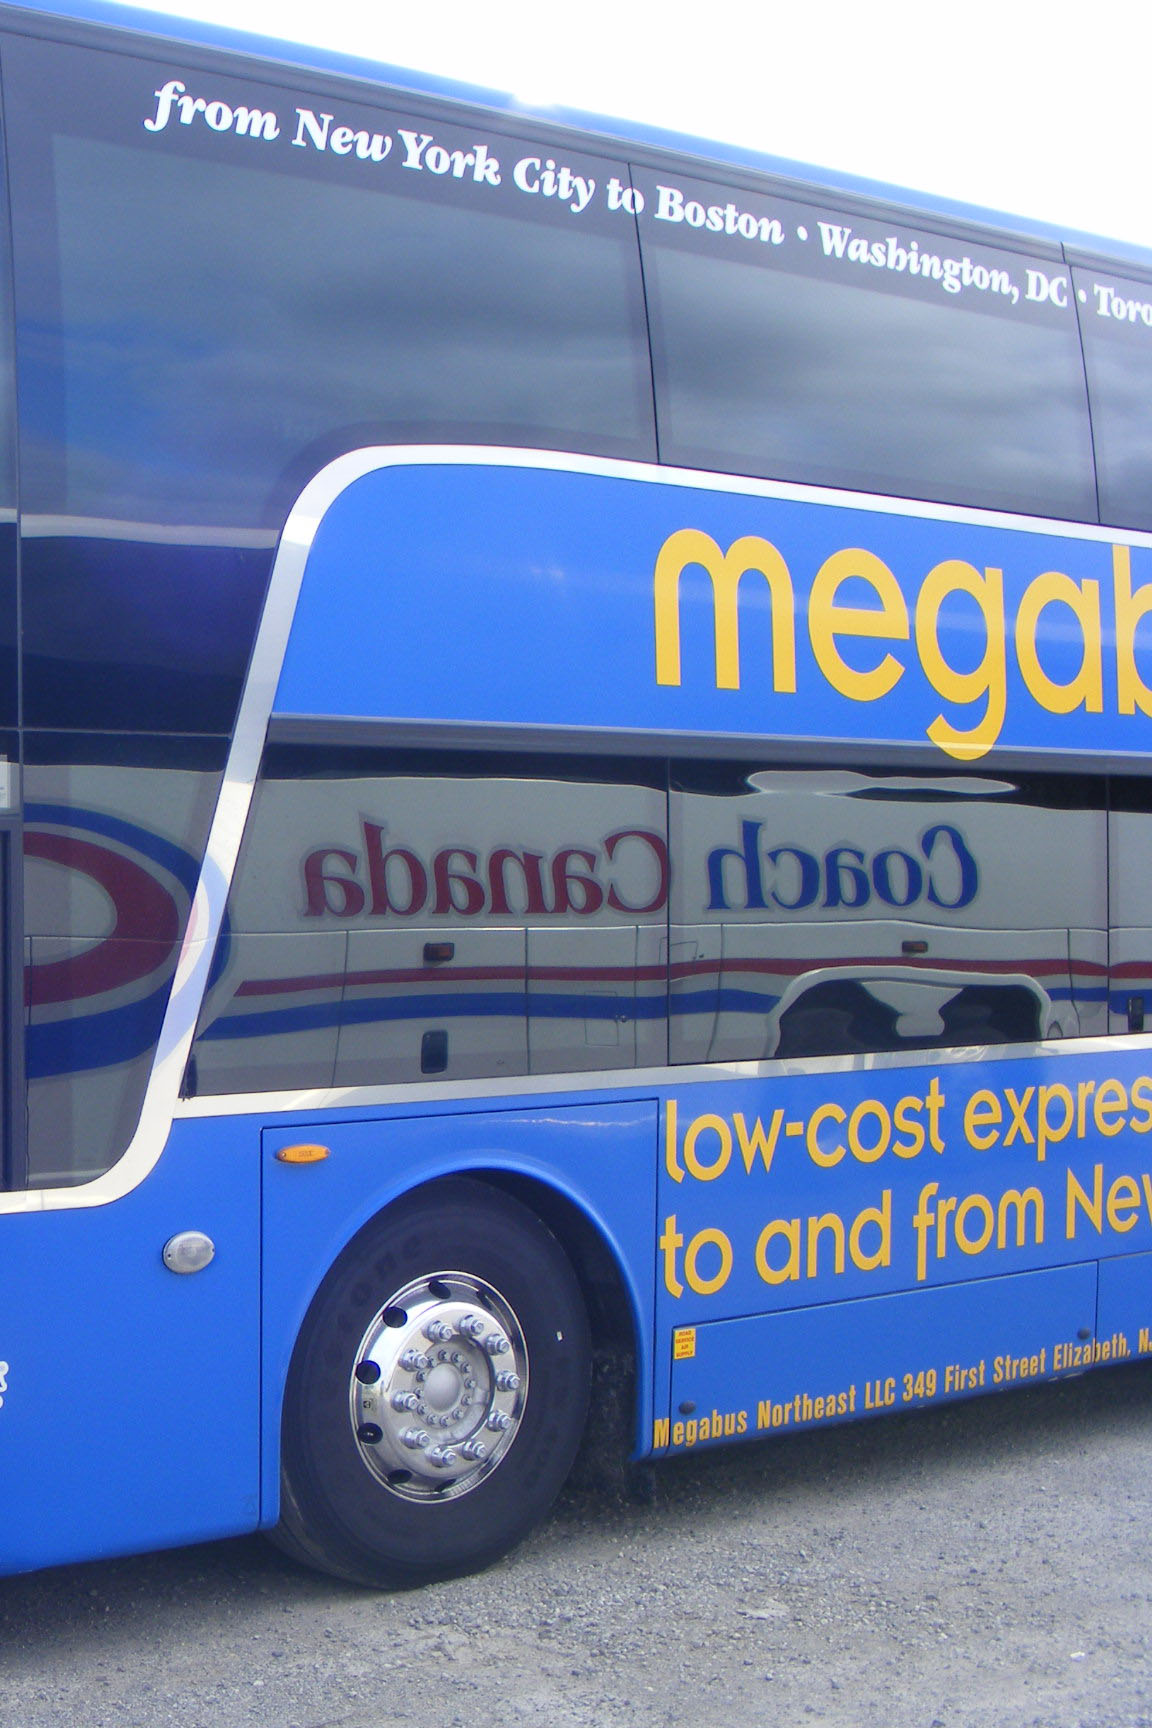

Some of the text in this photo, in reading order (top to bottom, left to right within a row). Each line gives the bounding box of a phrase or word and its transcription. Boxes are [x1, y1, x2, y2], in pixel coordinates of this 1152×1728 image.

[144, 81, 280, 141] from
[292, 108, 393, 162] New
[397, 127, 504, 187] York
[513, 157, 596, 213] City
[606, 177, 645, 214] to
[654, 185, 785, 245] Boston
[817, 221, 1020, 305] Washington,
[1024, 268, 1068, 308] DC
[664, 1076, 946, 1184] low-cost
[658, 1163, 1152, 1298] to and from Ne
[653, 1409, 749, 1450] Megabus
[756, 1385, 857, 1431] Northeast
[864, 1376, 897, 1410] LLC
[902, 1369, 938, 1401] 349
[945, 1360, 986, 1394] First
[993, 1349, 1047, 1385] Street
